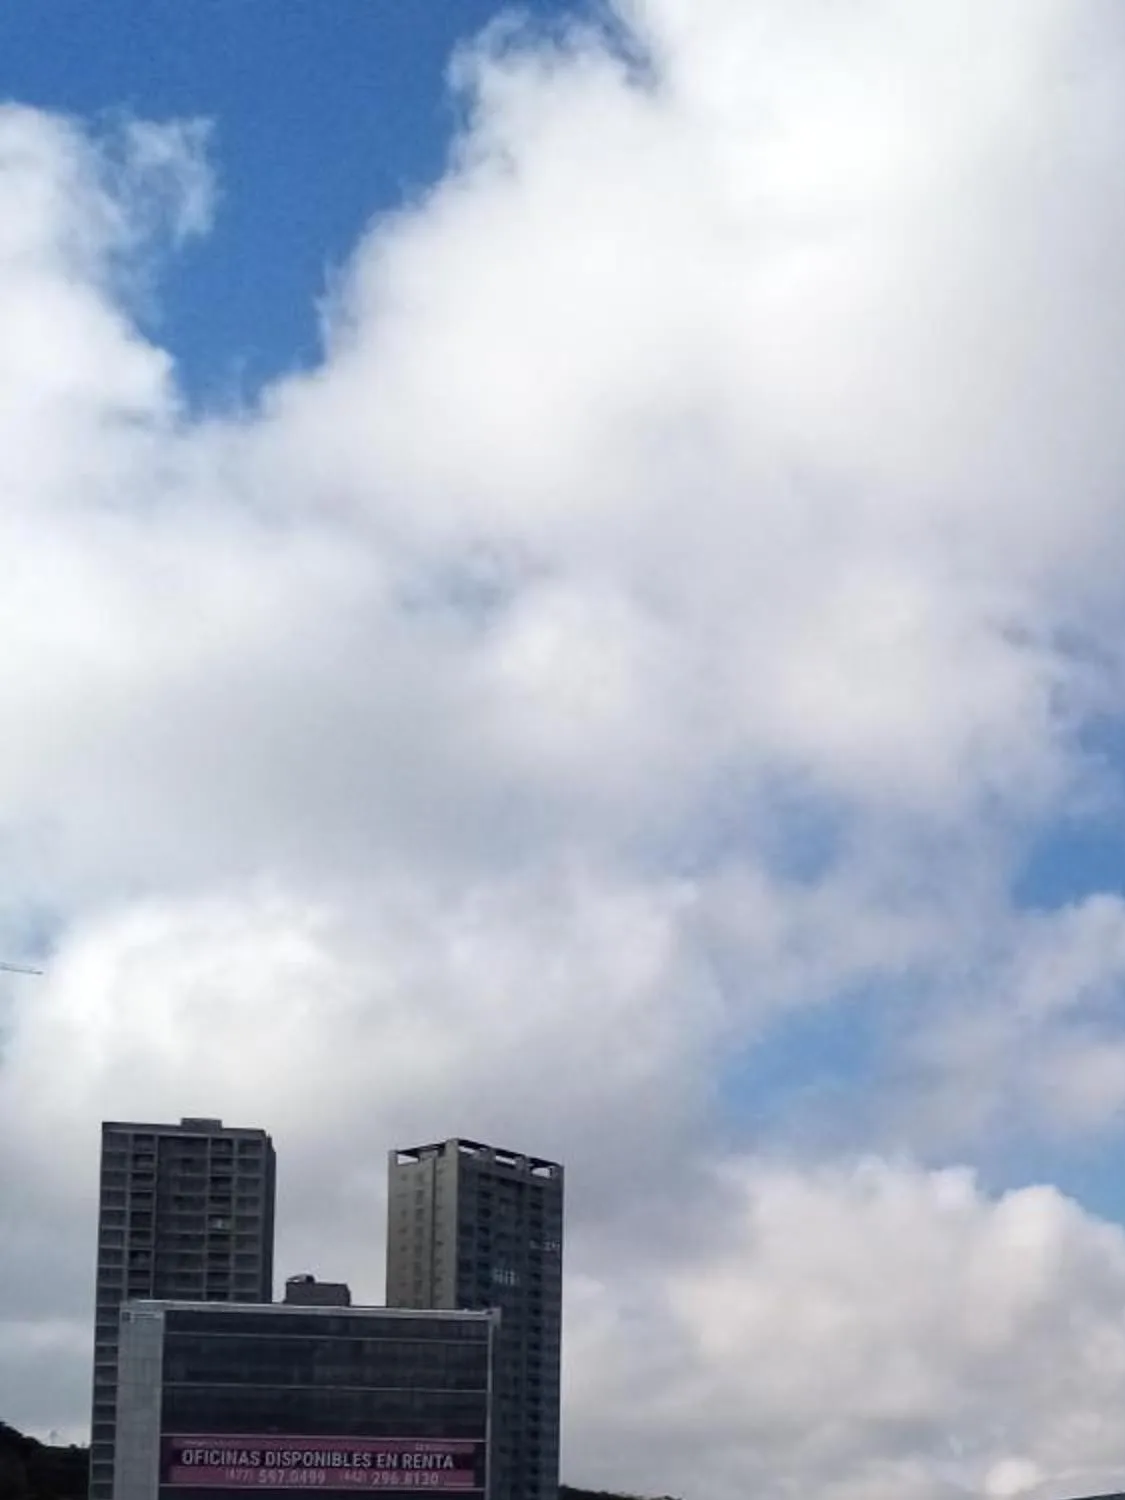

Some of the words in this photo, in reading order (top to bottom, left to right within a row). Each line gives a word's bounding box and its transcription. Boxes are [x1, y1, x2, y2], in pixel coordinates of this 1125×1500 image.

[181, 1449, 260, 1467] OFICINAS
[264, 1450, 373, 1468] DISPONIBLES
[376, 1452, 398, 1468] EN
[402, 1453, 453, 1470] RENTA
